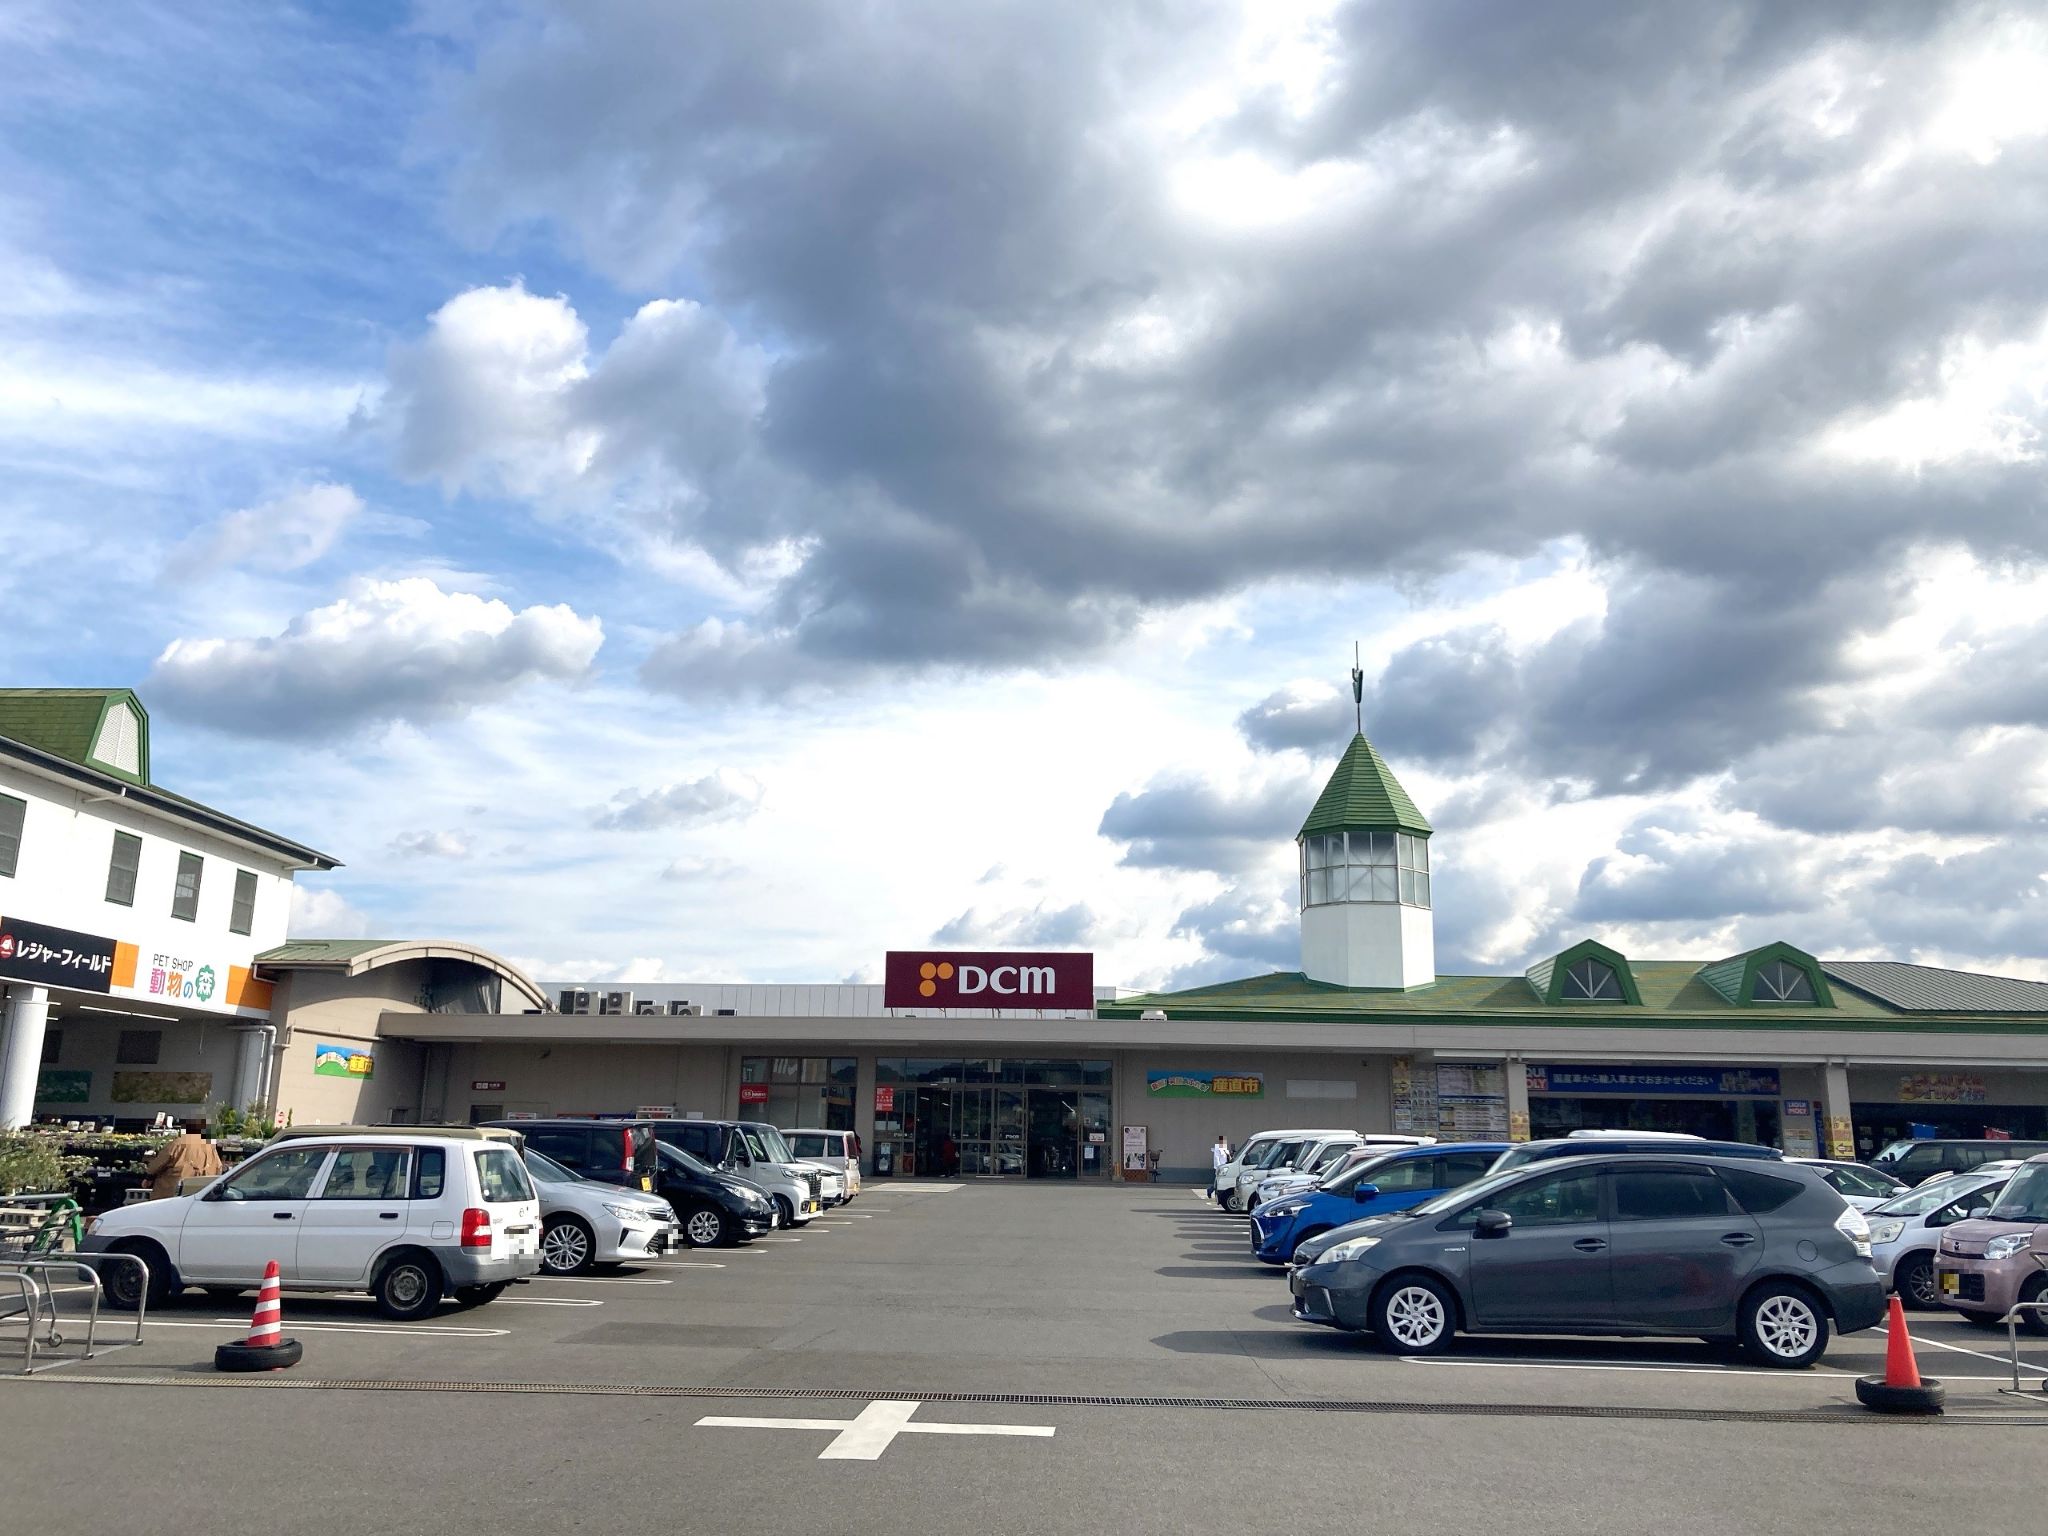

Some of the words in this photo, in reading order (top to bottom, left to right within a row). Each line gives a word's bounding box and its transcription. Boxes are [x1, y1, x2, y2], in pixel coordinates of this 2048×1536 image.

[16, 939, 112, 974] レジャーフィールド
[153, 953, 170, 967] PET
[171, 957, 194, 972] SHOP
[149, 966, 215, 1001] 動物の森
[1212, 1077, 1260, 1094] 産直市
